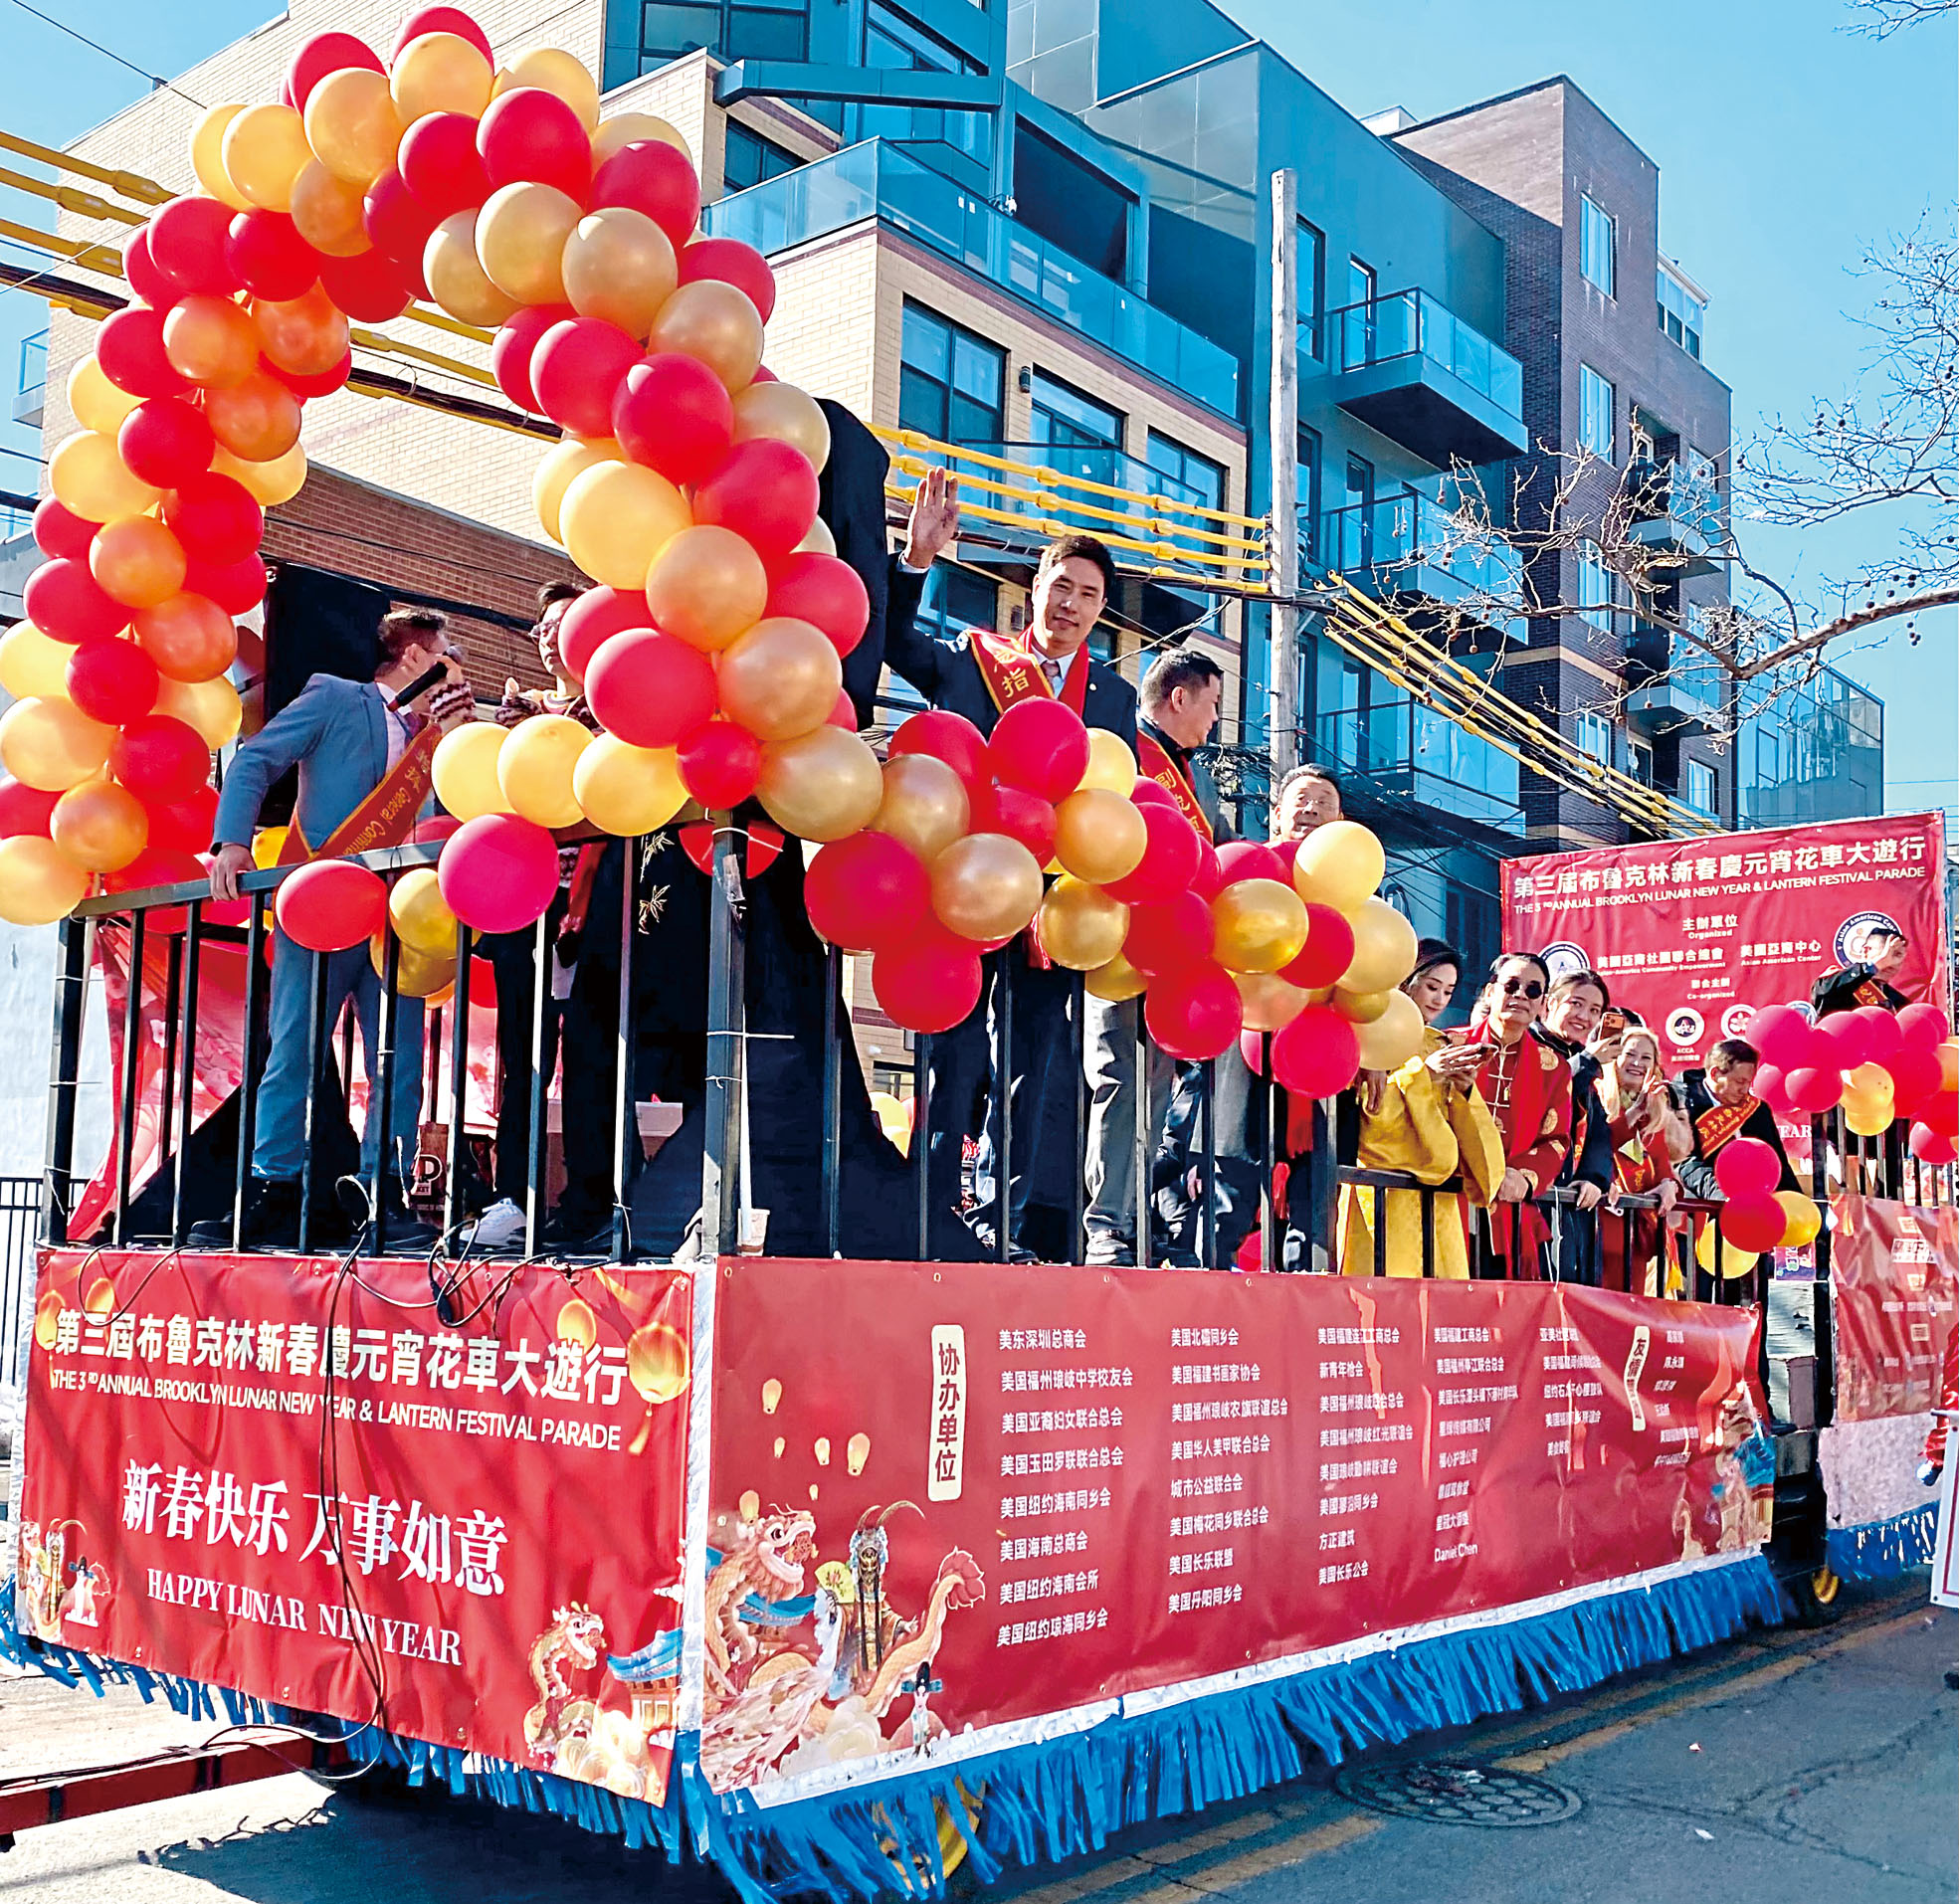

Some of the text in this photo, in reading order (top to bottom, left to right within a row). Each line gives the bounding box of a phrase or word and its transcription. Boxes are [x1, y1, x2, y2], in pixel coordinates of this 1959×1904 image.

[1514, 903, 1533, 914] THE
[1552, 897, 1595, 911] ANNUAL
[1596, 892, 1655, 907] BROOKLYN
[1656, 887, 1691, 901] LUNAR
[1692, 884, 1719, 898] NEW
[1721, 881, 1751, 895] YEAR
[1753, 881, 1763, 892] &
[1764, 876, 1818, 891] LANTERN
[1819, 870, 1873, 887] FESTIVAL
[1874, 865, 1926, 880] PARADE
[1688, 929, 1733, 940] Organized
[1762, 956, 1795, 965] American
[999, 1328, 1086, 1351] 美东深圳总商会
[53, 1369, 78, 1391] THE
[98, 1375, 151, 1398] ANNUAL
[154, 1379, 227, 1406] BROOKLYN
[229, 1387, 277, 1411] LUNAR
[280, 1392, 315, 1415] NEW
[359, 1400, 373, 1422] &
[379, 1401, 454, 1430] LANTERN
[457, 1410, 536, 1440] FESTIVAL
[541, 1419, 621, 1450] PARADE
[935, 1342, 960, 1483] 协办单位
[1002, 1407, 1123, 1433] 美国亚裔妇女联合总会
[1171, 1434, 1271, 1460] 美国华人美甲联合总会
[1171, 1473, 1243, 1498] 城市公益联合会
[1000, 1487, 1111, 1519] 美国纽约海南同乡会
[123, 1459, 508, 1598] 新春快乐 万事如意
[1000, 1531, 1088, 1562] 美国海南总商会
[1000, 1569, 1098, 1606] 美国纽约海南会所
[147, 1568, 223, 1615] HAPPY
[227, 1586, 306, 1632] LUNAR
[382, 1618, 463, 1666] YEAR
